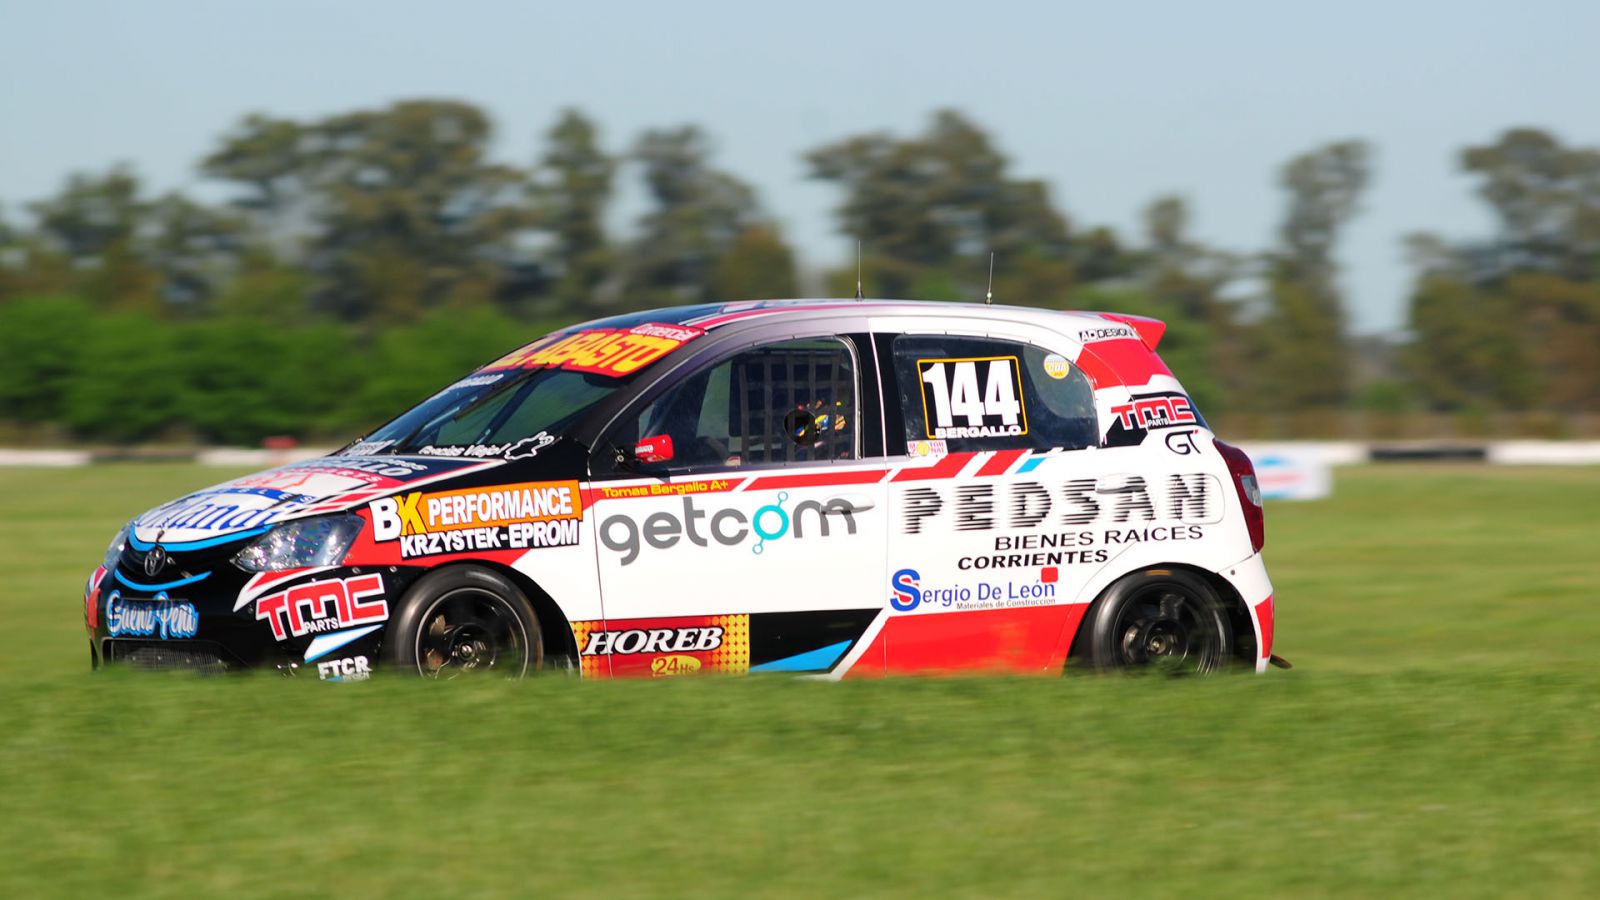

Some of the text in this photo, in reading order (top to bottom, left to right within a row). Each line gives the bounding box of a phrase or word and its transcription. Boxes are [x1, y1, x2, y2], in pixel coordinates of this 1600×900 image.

[514, 331, 681, 373] ABASTO
[922, 360, 1020, 428] 144
[1110, 396, 1197, 431] TMC
[1147, 418, 1169, 427] PARTS
[935, 424, 1021, 439] BERGALLO
[1165, 430, 1201, 455] GT
[602, 479, 728, 498] Tomas Bergallo A+
[902, 473, 1208, 534] PEDSAN
[369, 487, 573, 543] BK PERFORMANCE
[599, 491, 858, 566] getcom
[401, 519, 579, 559] KRZYSTEK-EPROM
[994, 525, 1204, 551] BIENES RAICES
[957, 549, 1108, 570] CORRIENTES
[890, 568, 1055, 612] Sergio De León
[255, 572, 389, 642] TMC
[956, 602, 994, 610] Materiales
[303, 617, 339, 633] PARTS
[580, 626, 725, 657] HOREB
[317, 655, 373, 681] FTCR
